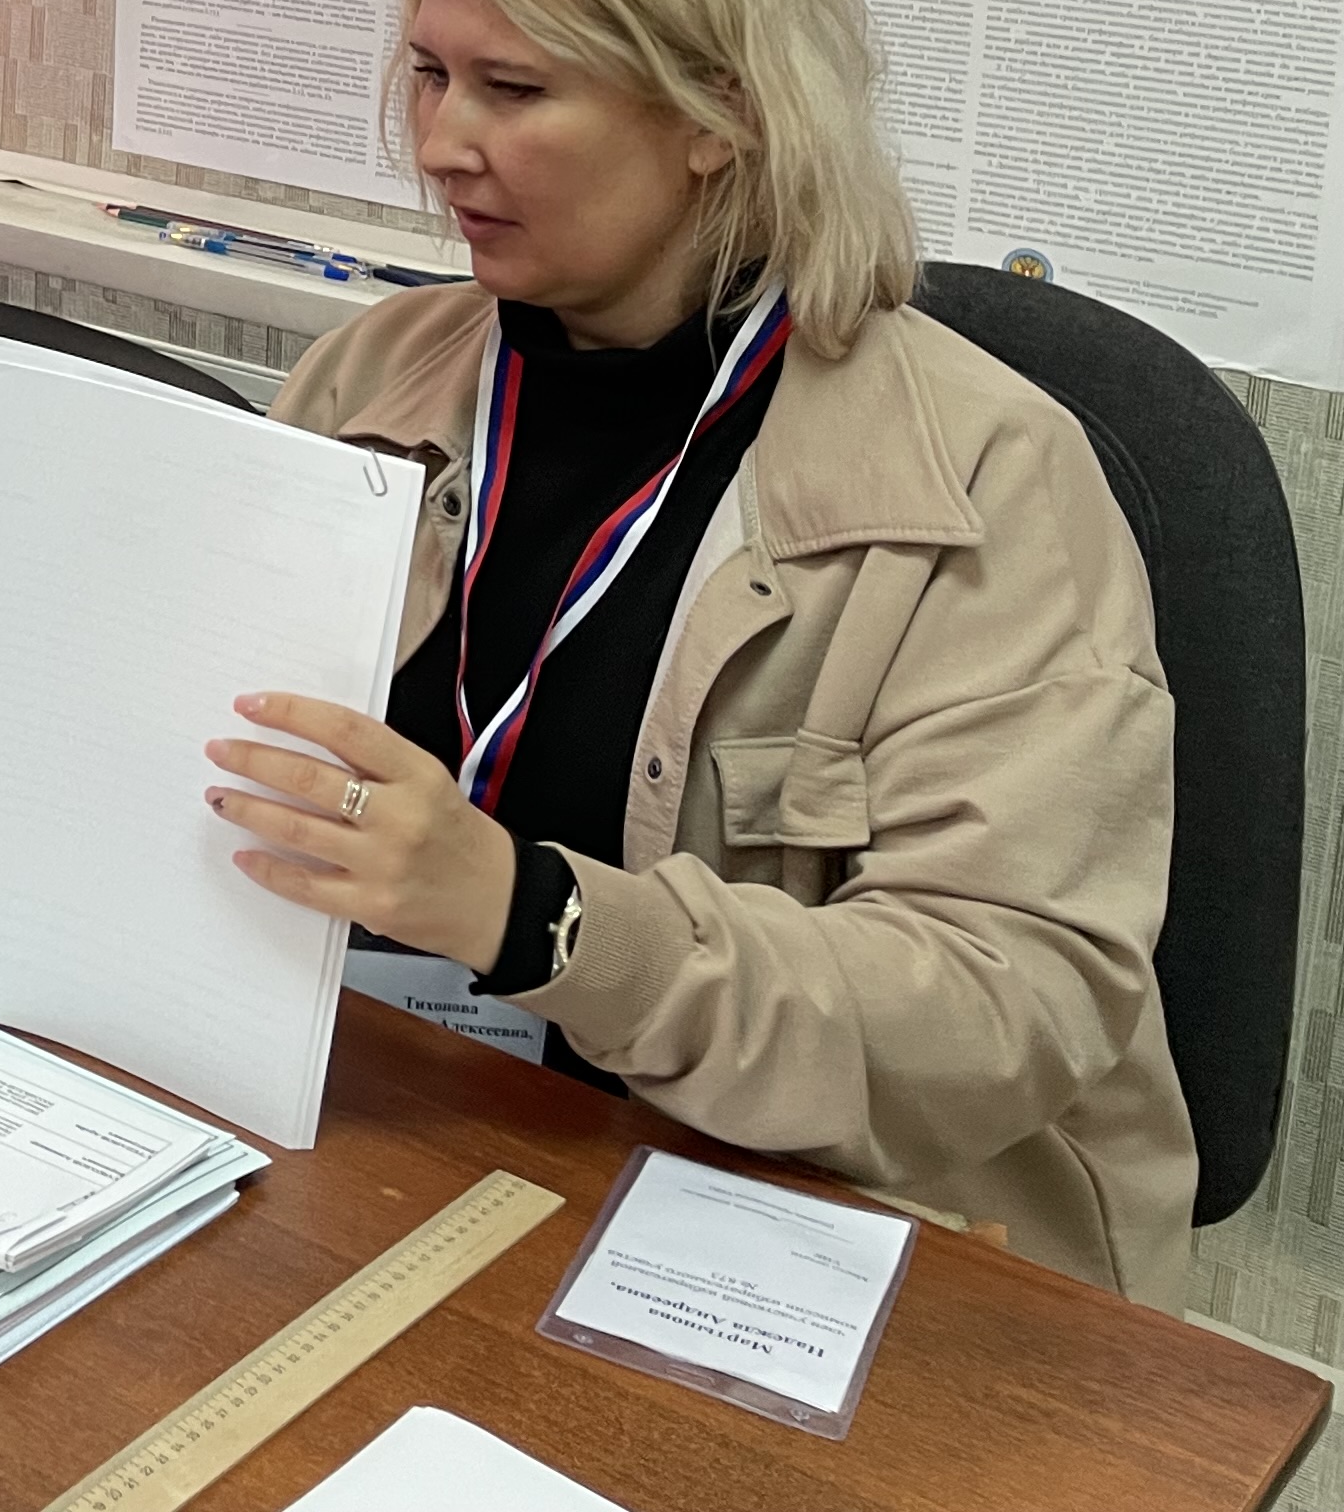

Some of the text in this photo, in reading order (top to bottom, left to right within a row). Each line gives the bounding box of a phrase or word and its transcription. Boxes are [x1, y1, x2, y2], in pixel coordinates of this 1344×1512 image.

[403, 995, 479, 1016] Тихонова
[648, 1308, 773, 1355] Мартынова
[733, 1321, 824, 1358] Надежда
